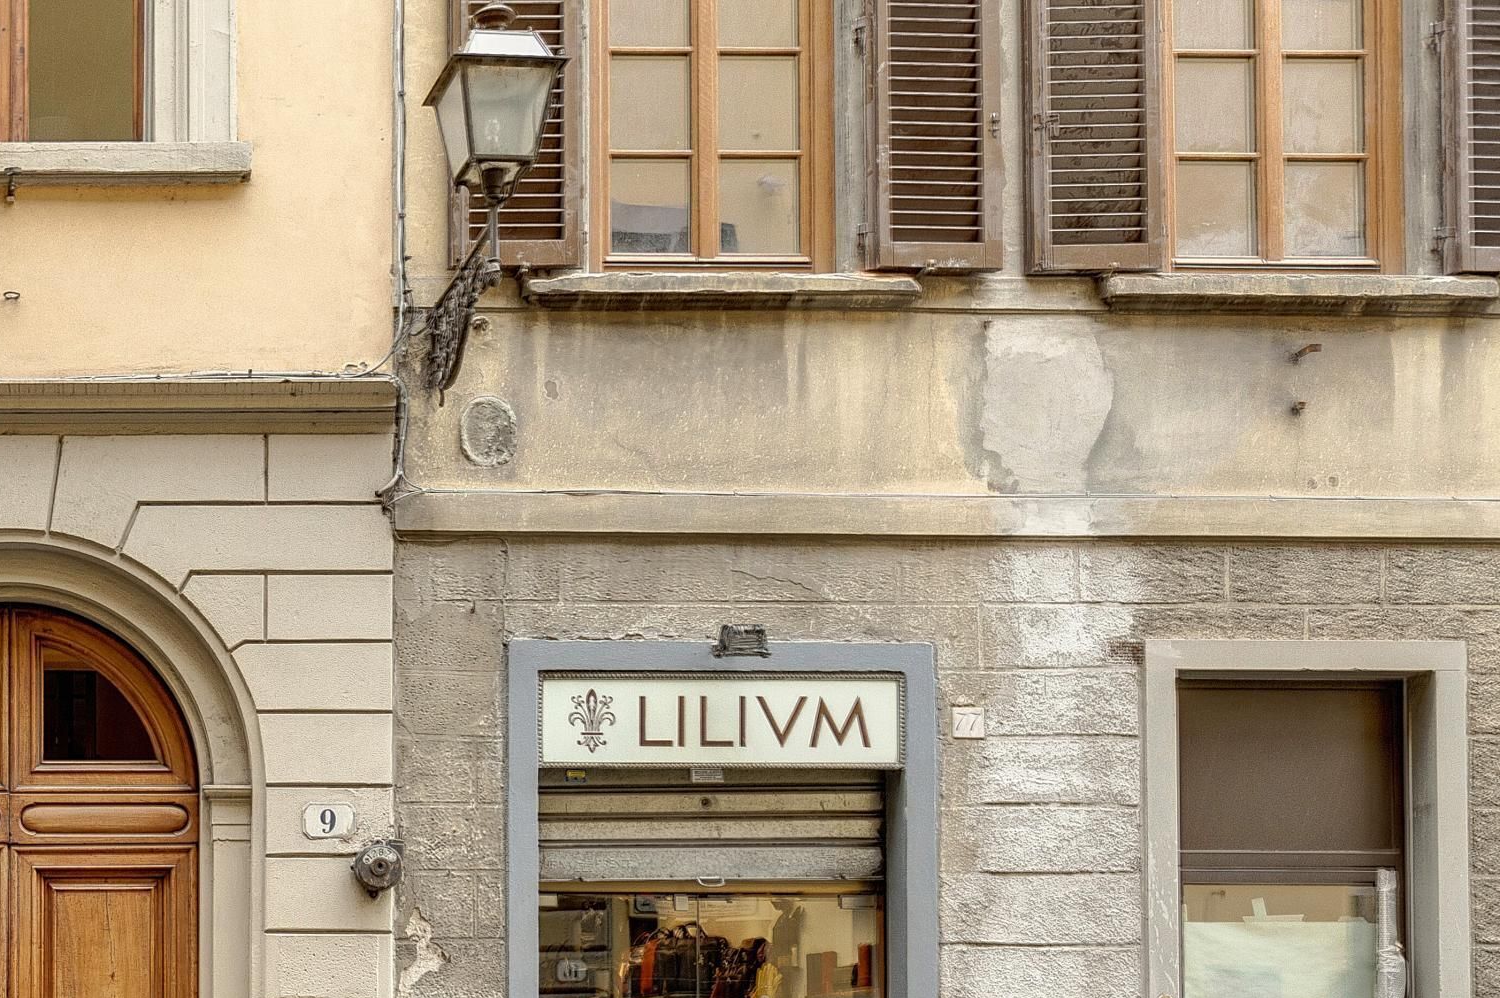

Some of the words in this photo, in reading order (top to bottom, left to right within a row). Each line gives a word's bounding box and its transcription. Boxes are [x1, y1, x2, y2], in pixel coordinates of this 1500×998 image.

[639, 695, 871, 747] LILIVM
[955, 712, 981, 732] 77
[319, 808, 336, 834] 9
